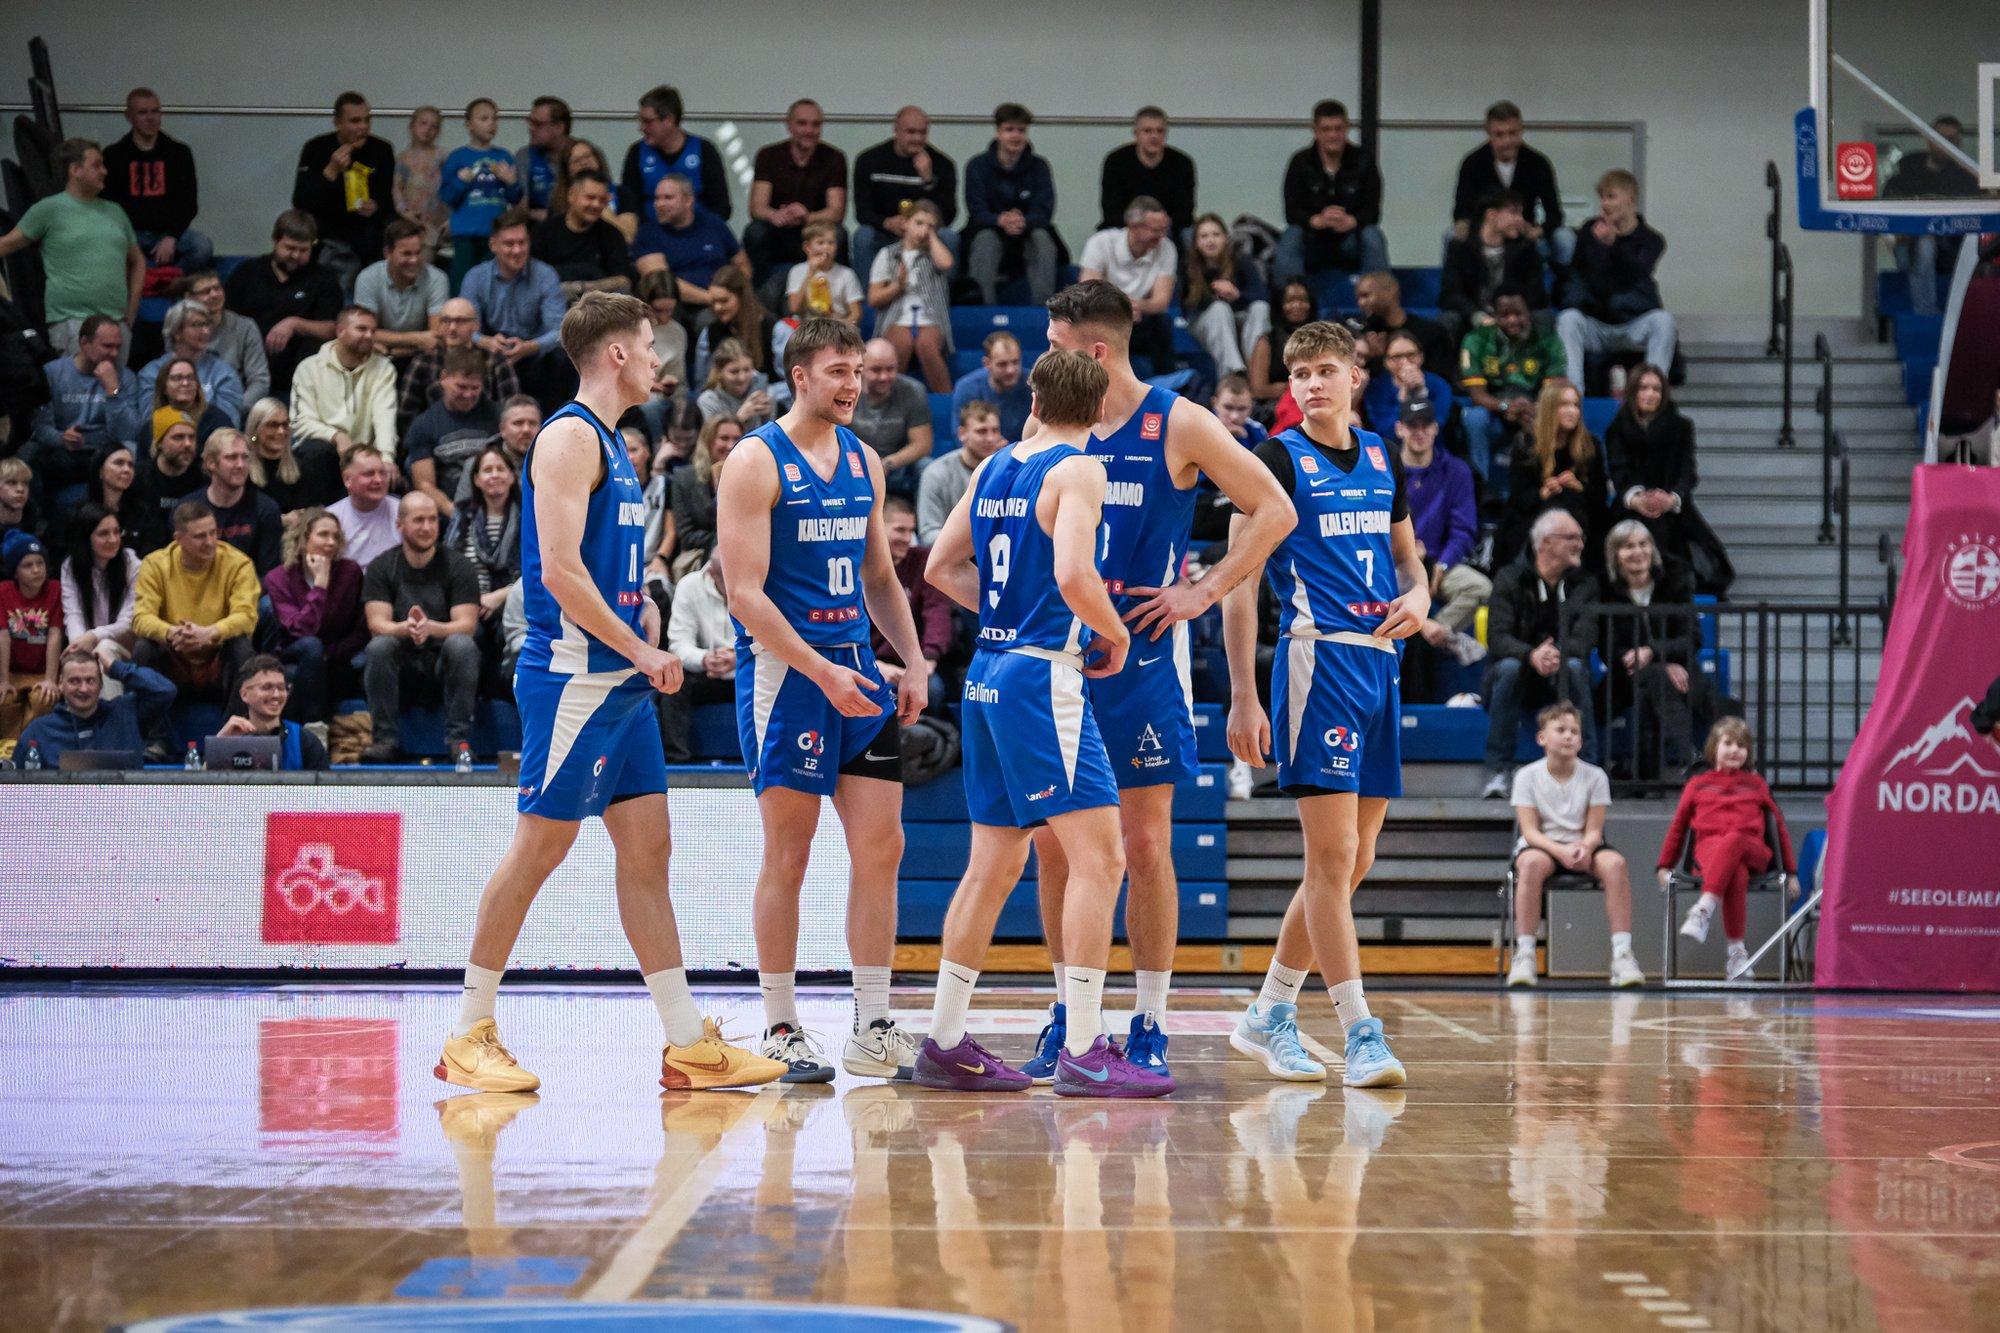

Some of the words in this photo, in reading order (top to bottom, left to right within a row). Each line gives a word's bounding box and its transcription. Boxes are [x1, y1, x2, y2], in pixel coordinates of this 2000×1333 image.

[821, 498, 846, 506] UNIBET
[827, 556, 855, 596] 10
[988, 533, 1011, 610] 9
[1356, 550, 1375, 588] 7
[964, 680, 999, 704] Tallinn
[1144, 757, 1170, 768] Medical
[1876, 780, 2000, 815] NORDA
